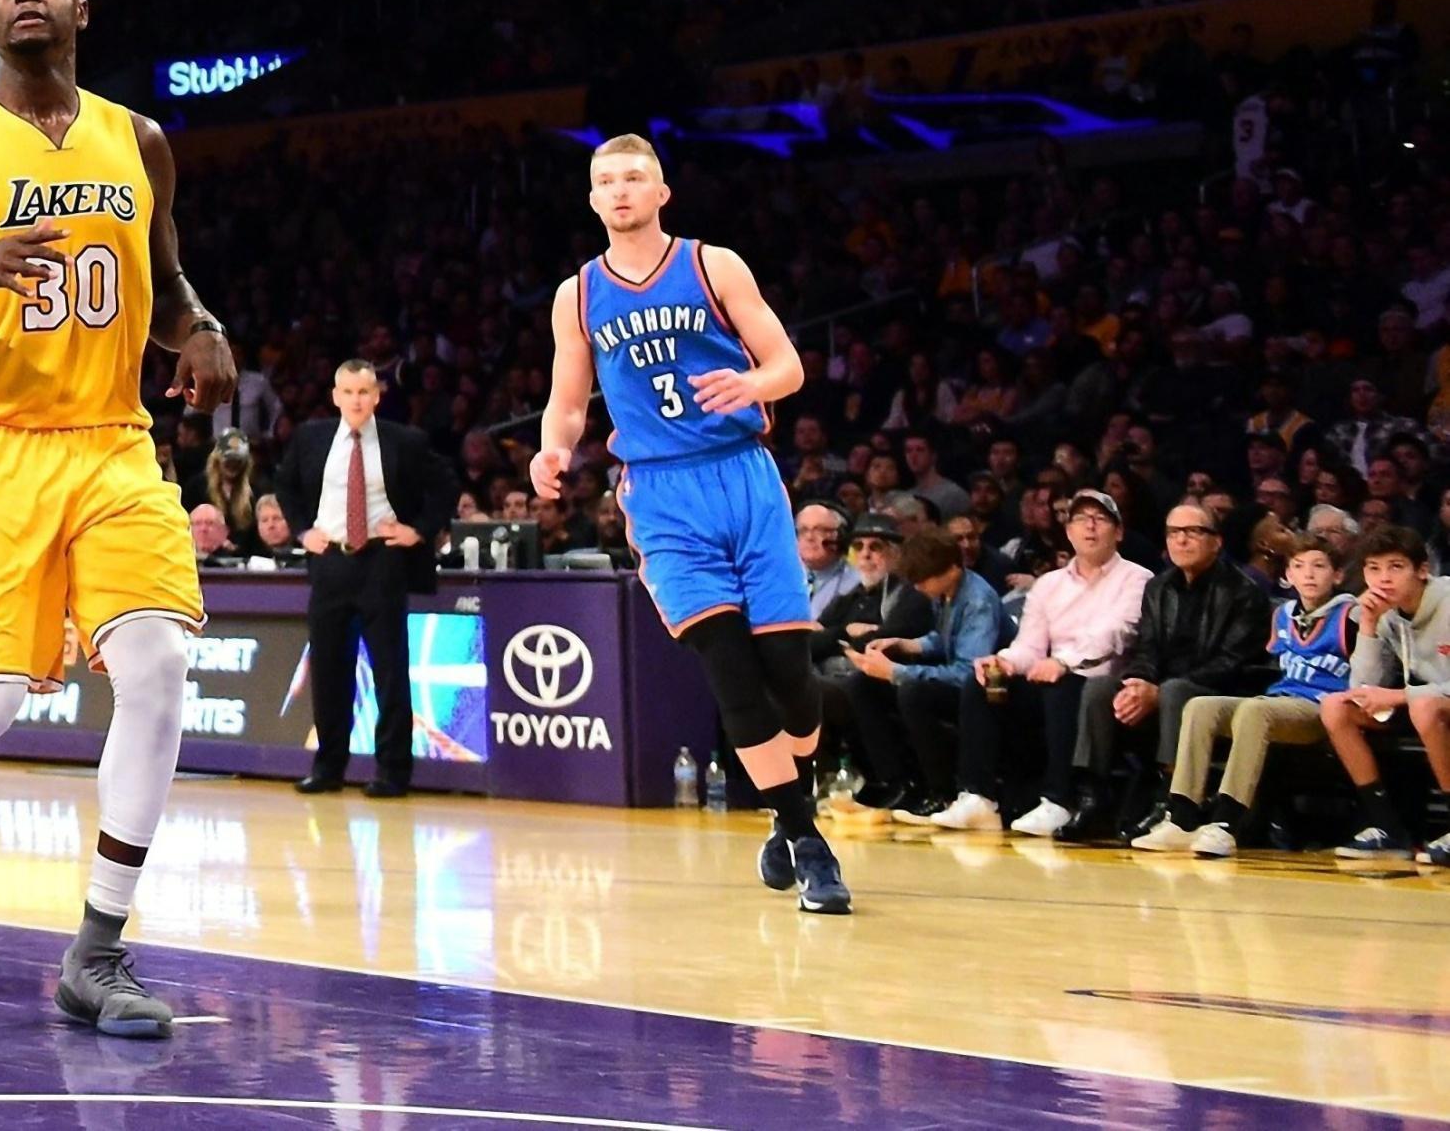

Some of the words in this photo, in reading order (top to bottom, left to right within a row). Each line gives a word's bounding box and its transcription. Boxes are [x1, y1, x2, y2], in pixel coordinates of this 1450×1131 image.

[0, 179, 136, 229] LAKERS
[22, 244, 120, 333] 30
[594, 305, 706, 353] OKLAHOMA
[629, 336, 677, 369] CITY
[652, 372, 685, 419] 3
[489, 711, 613, 751] TOYOTA
